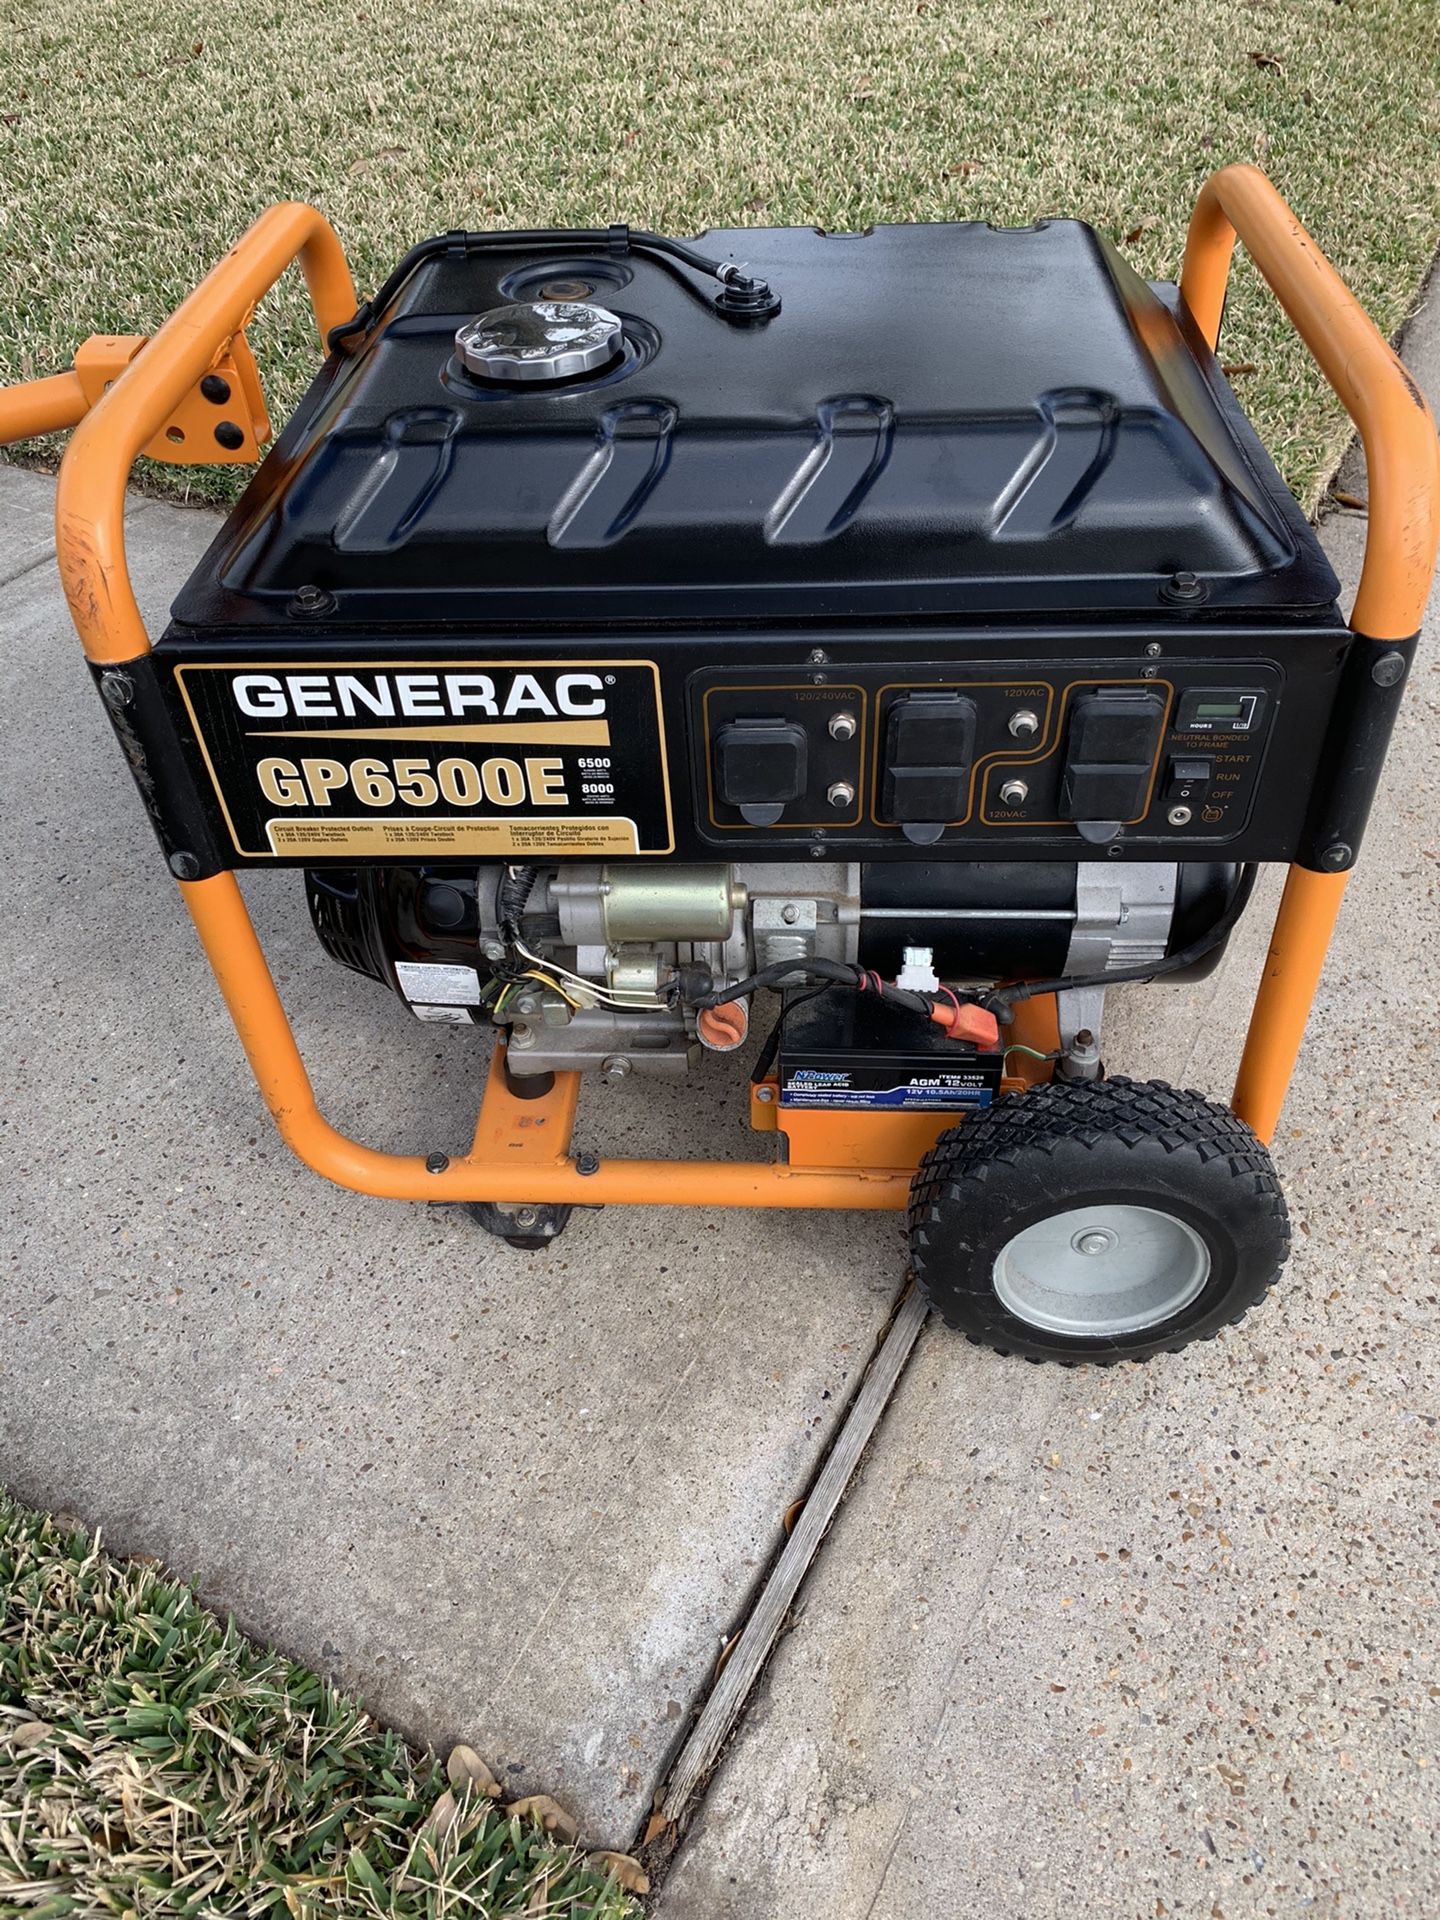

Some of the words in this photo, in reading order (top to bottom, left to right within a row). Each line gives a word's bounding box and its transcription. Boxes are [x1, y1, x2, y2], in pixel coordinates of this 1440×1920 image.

[792, 690, 856, 701] 120/240VAC
[1003, 688, 1045, 698] 120VAC
[577, 757, 611, 768] 6500
[1216, 755, 1251, 763] START
[256, 757, 570, 807] GP6500E
[1216, 773, 1241, 781] RUN
[581, 783, 614, 794] 8000
[1212, 791, 1233, 799] OFF
[988, 809, 1028, 819] 120VAC
[910, 1078, 940, 1087] AGM
